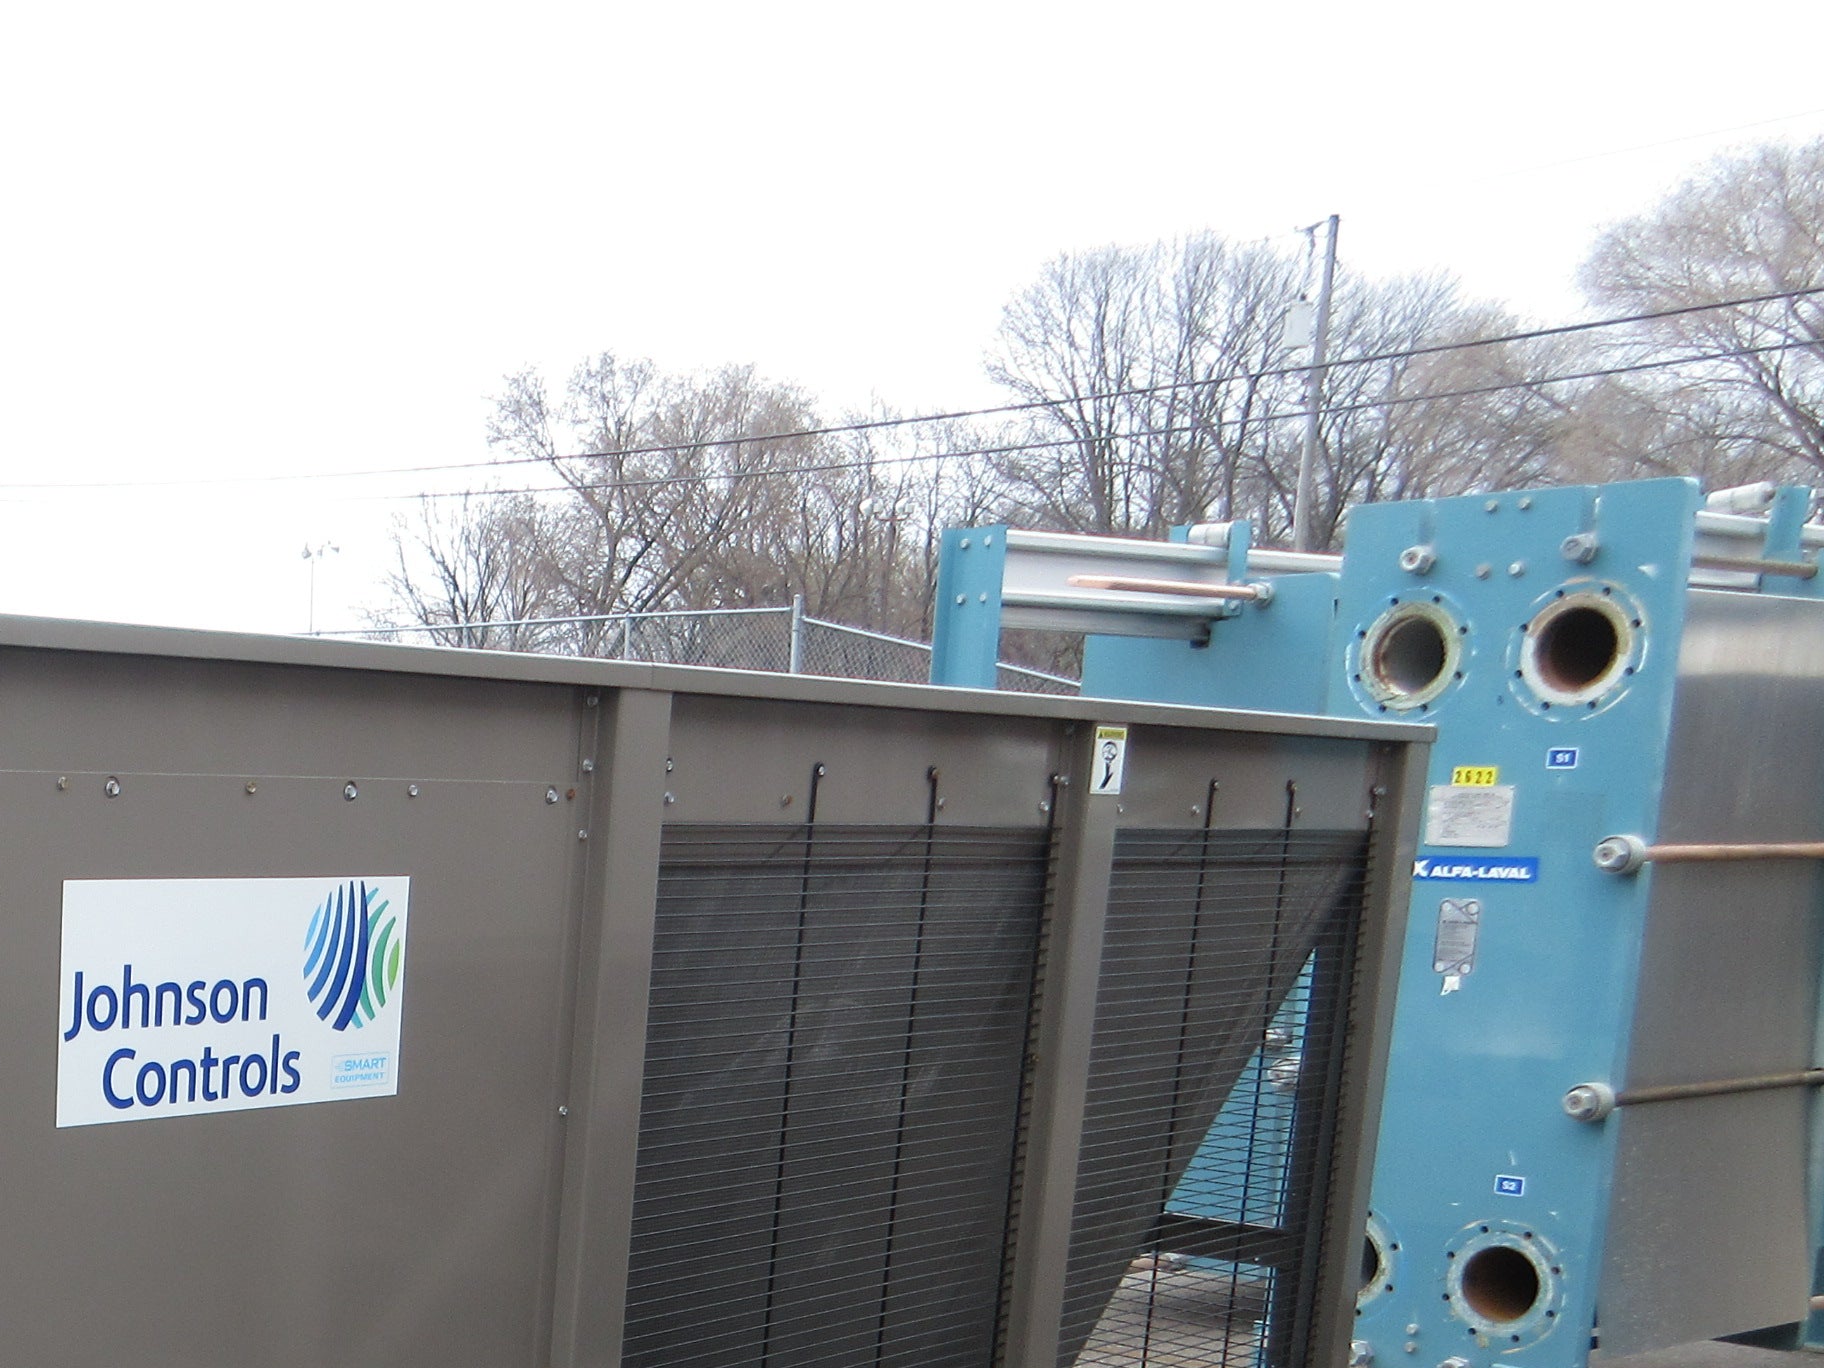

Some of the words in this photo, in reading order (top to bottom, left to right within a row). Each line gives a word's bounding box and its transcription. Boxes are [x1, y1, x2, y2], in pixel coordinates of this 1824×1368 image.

[1554, 752, 1570, 763] S1
[1429, 865, 1531, 879] ALFA-LAVAL
[63, 964, 268, 1043] Johnson
[344, 1057, 387, 1071] SMART
[102, 1034, 301, 1109] Controls
[335, 1072, 384, 1083] EQUIPMENT
